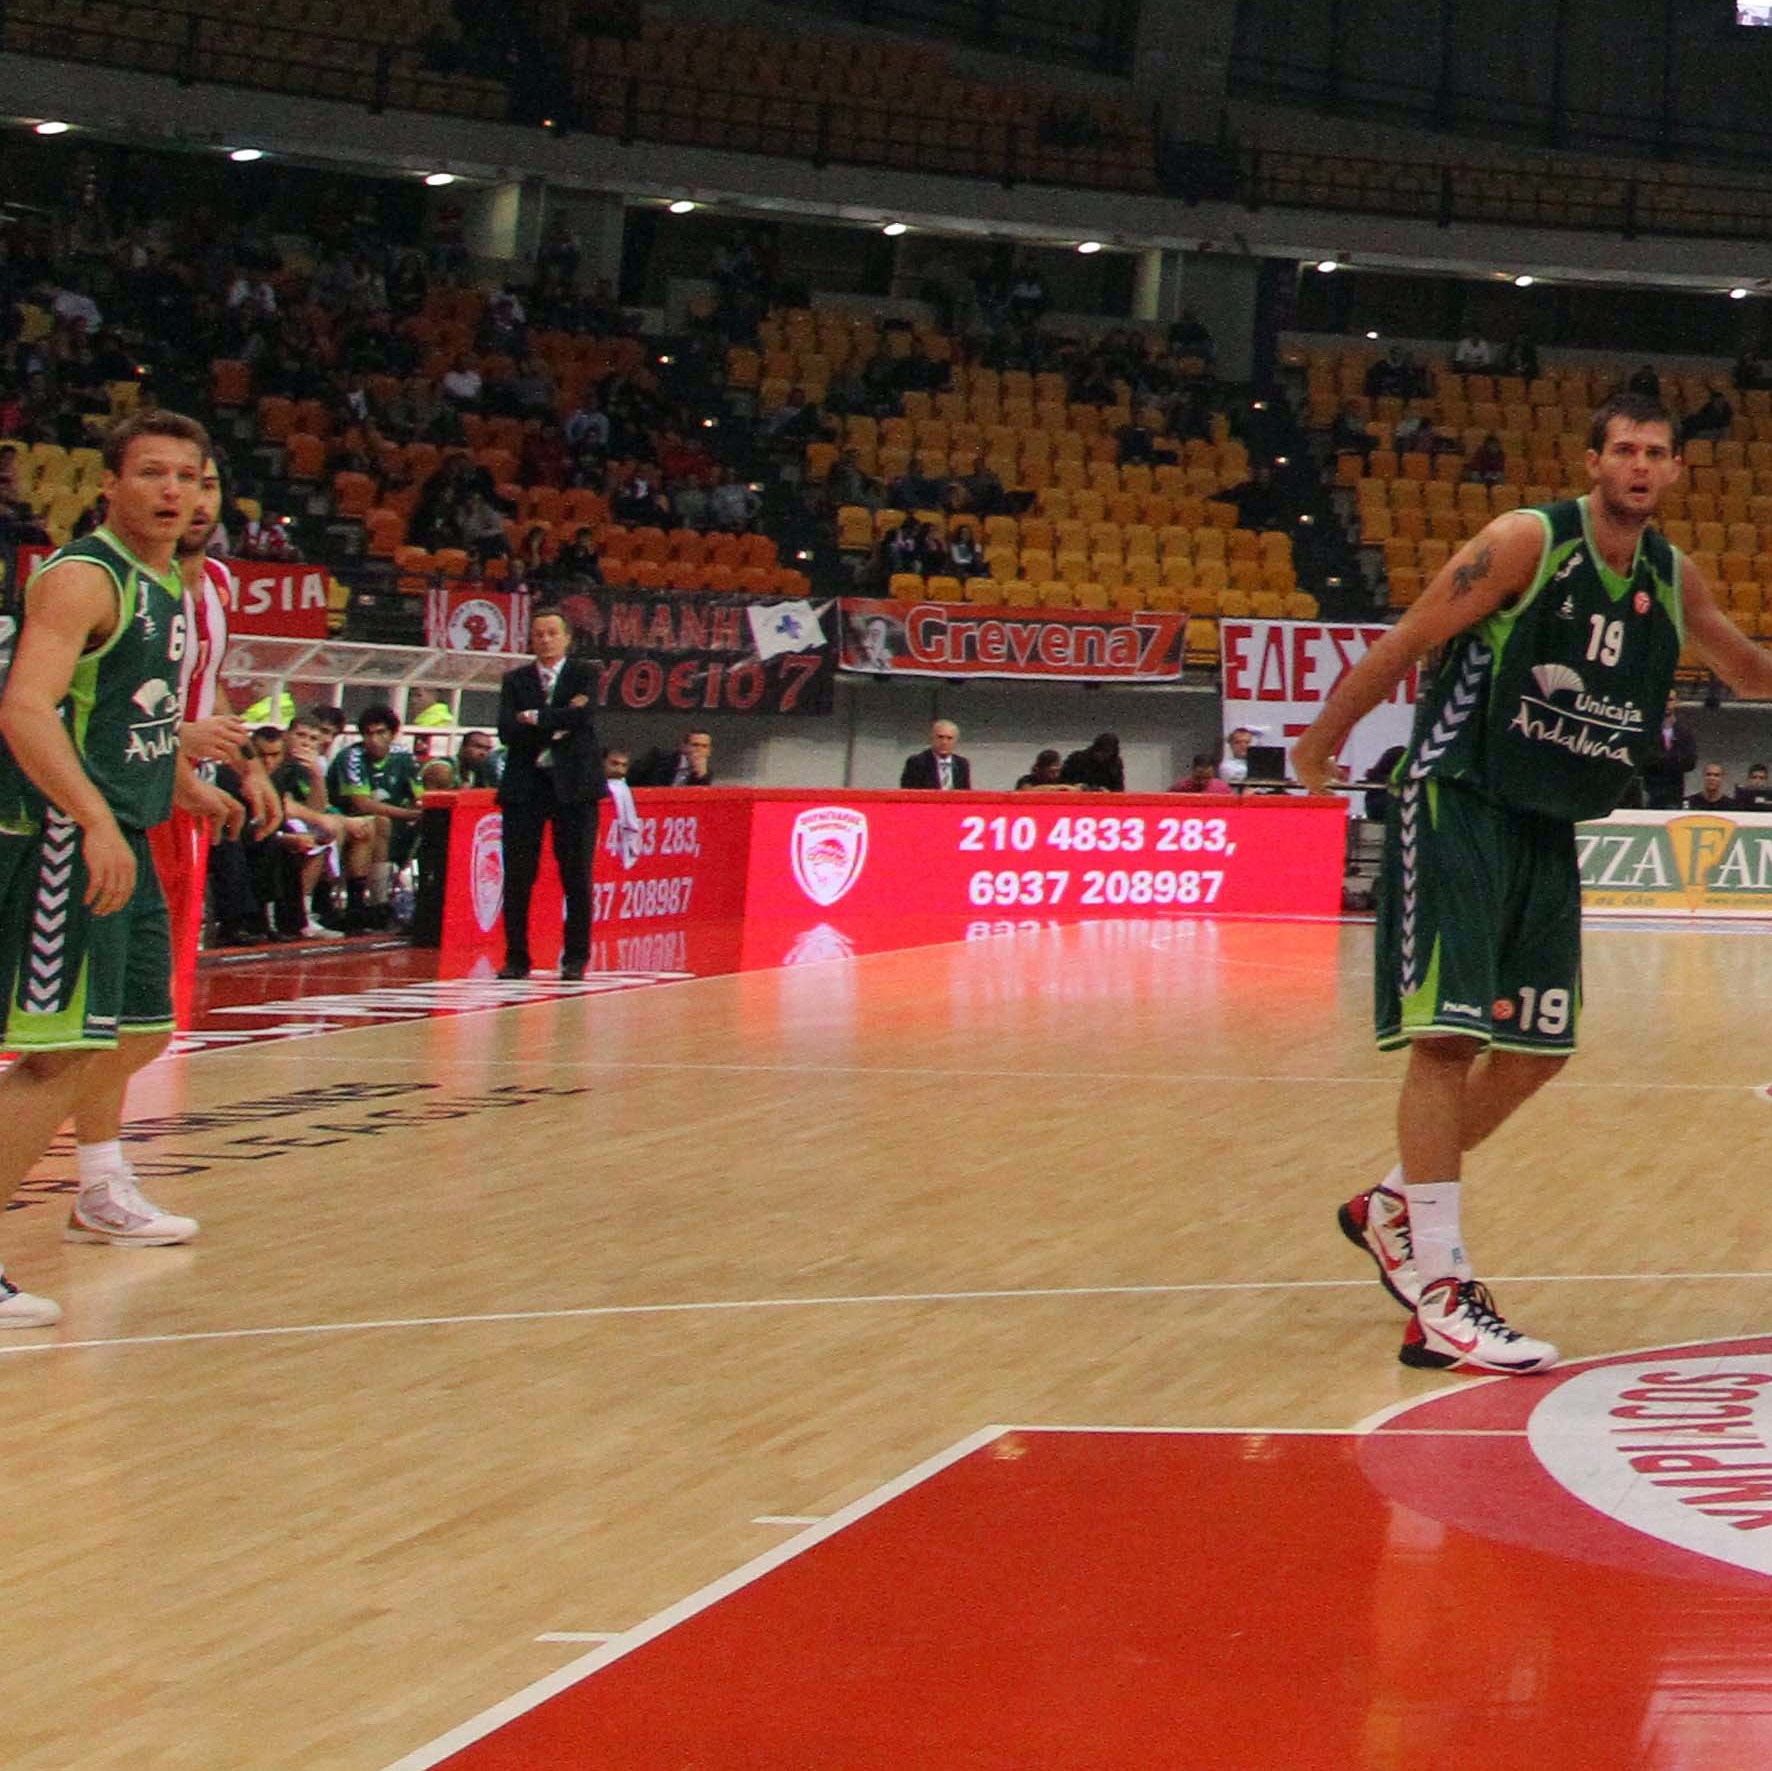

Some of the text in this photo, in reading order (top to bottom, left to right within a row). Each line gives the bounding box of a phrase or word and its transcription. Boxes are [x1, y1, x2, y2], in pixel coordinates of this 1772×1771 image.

[1224, 624, 1418, 705] ΕΔΕΣ
[1586, 612, 1625, 668] 19
[592, 657, 766, 710] ΥΘΕΙΟ
[1574, 692, 1643, 727] Unicaja
[959, 816, 1236, 857] 210 4833 283,
[1575, 834, 1673, 888] ZZA
[619, 876, 694, 920] 208987
[969, 870, 1225, 906] 6937 208987
[1518, 985, 1570, 1035] 19
